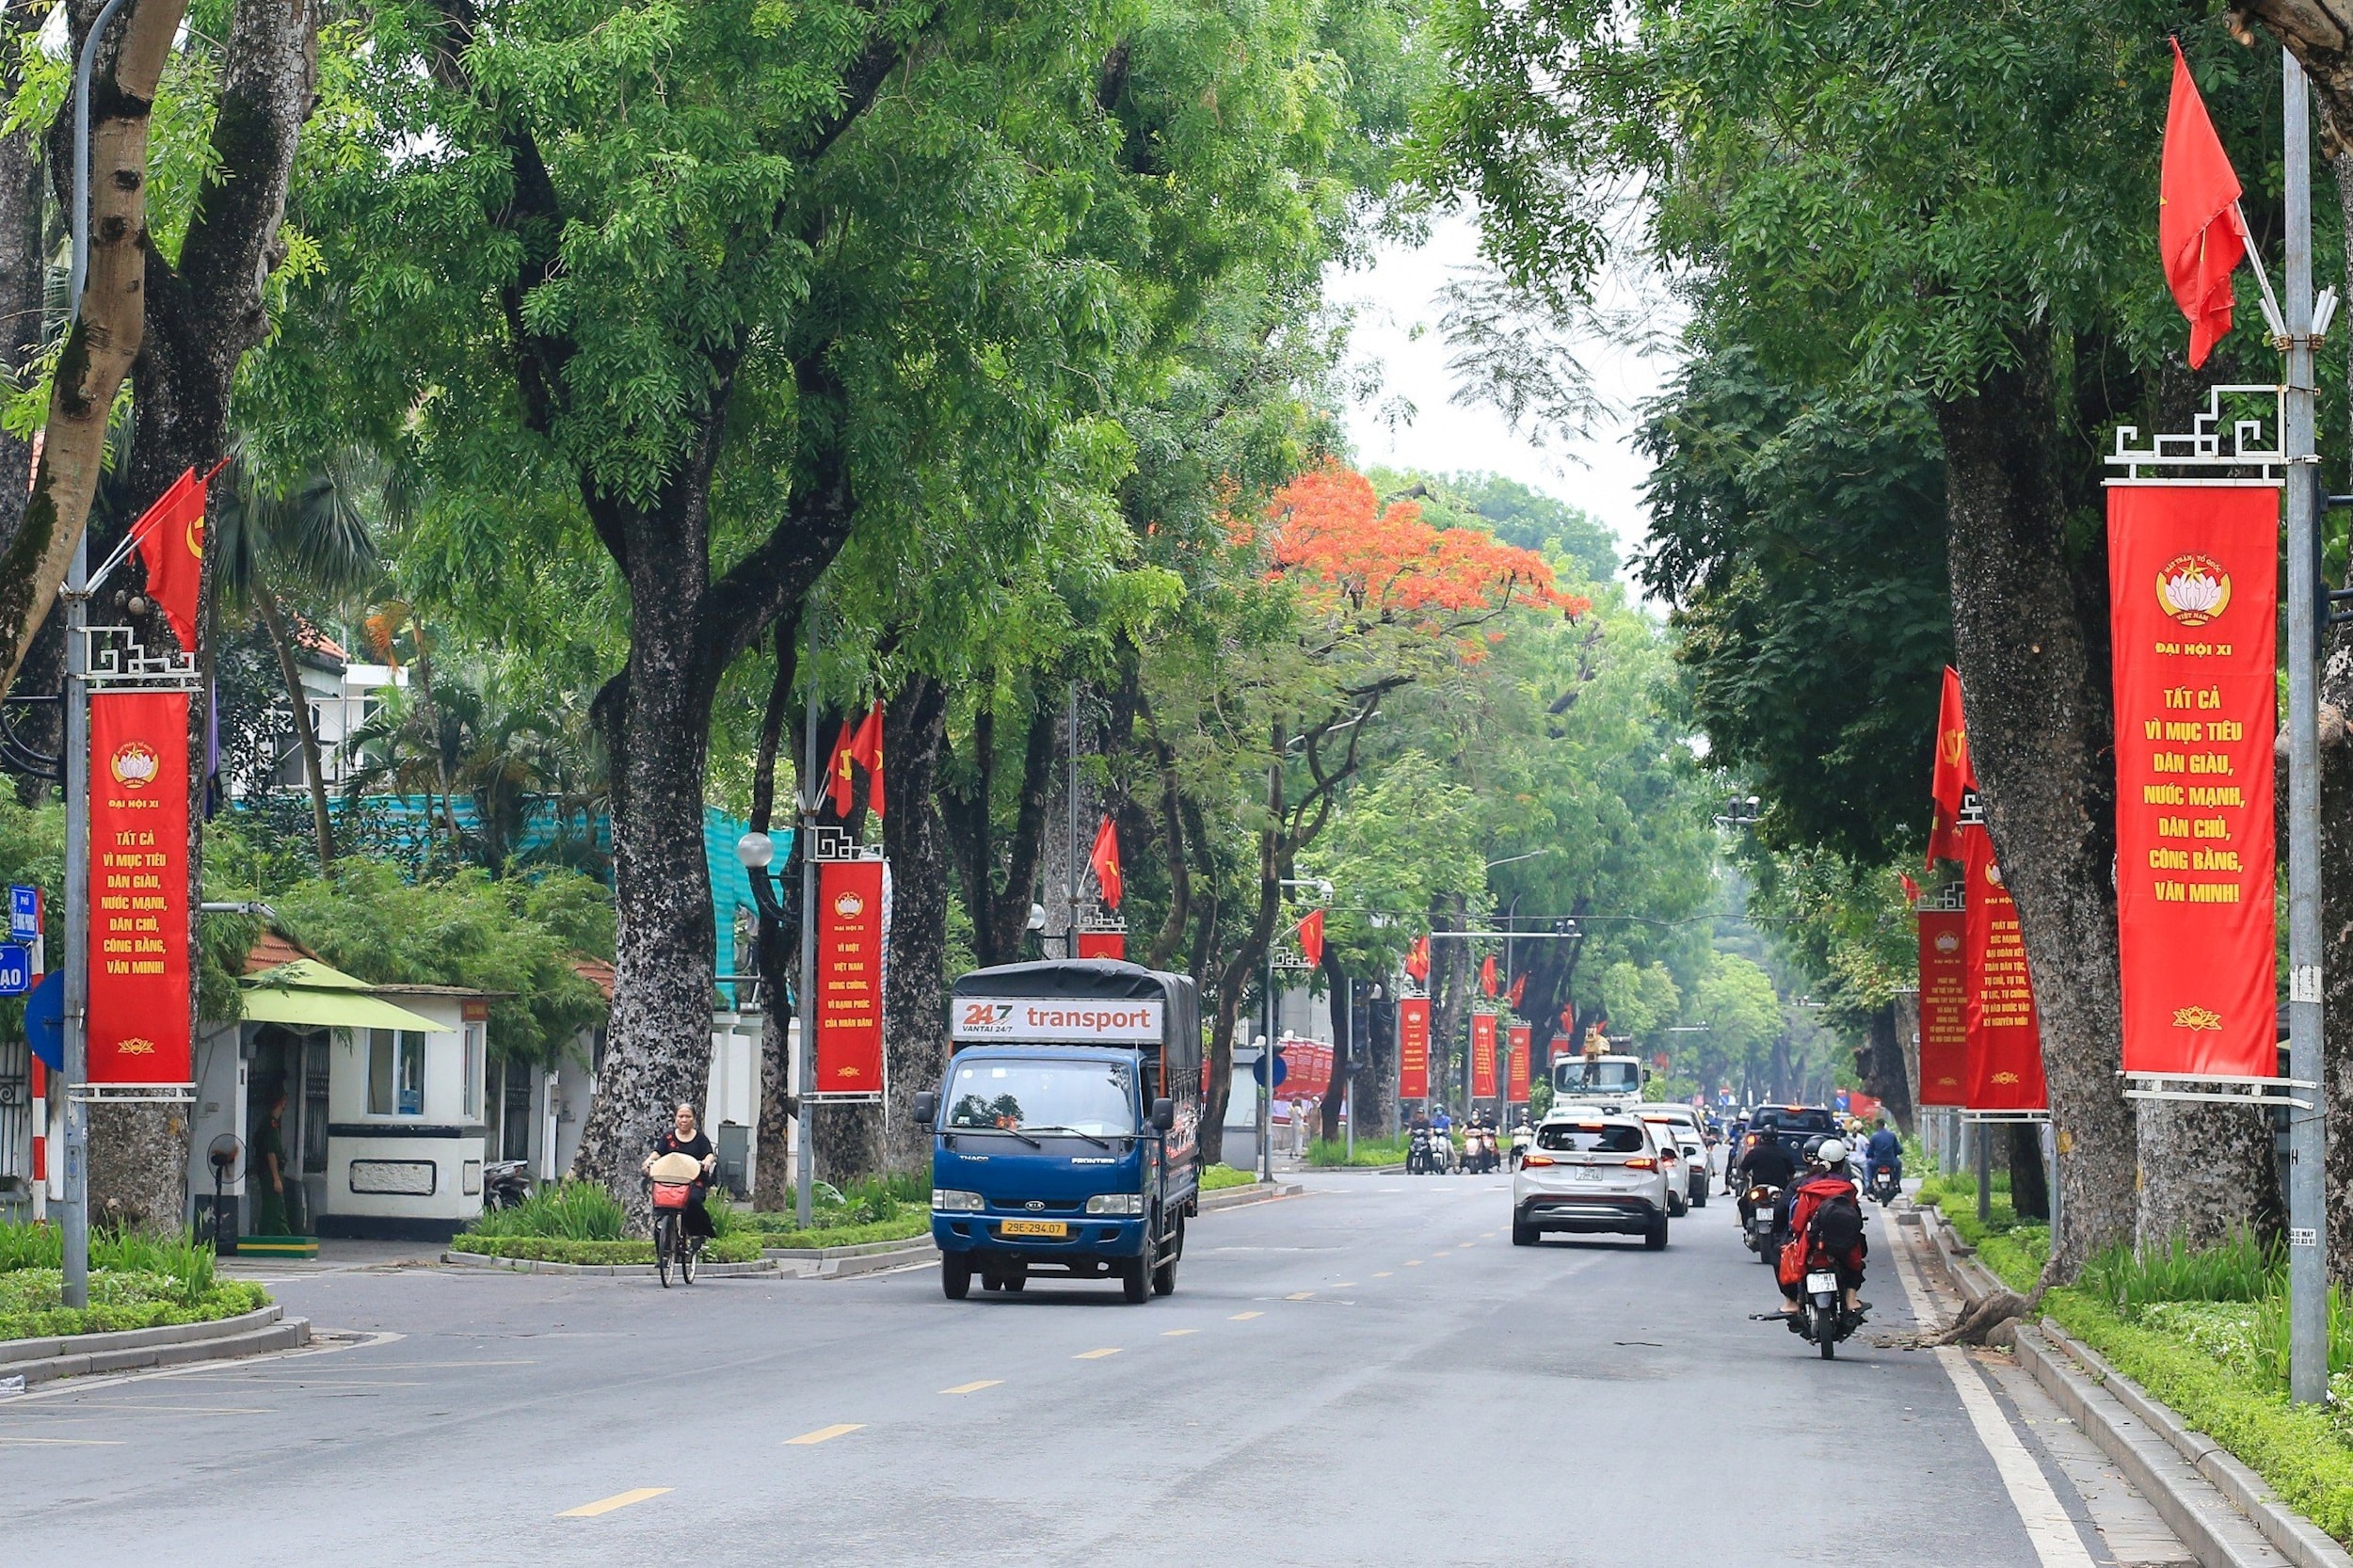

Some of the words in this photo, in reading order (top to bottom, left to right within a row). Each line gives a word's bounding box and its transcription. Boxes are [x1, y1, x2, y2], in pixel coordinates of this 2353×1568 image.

[2177, 612, 2192, 620] VIỆT
[2193, 613, 2209, 621] NAM
[2155, 642, 2180, 656] ĐẠI
[2184, 642, 2212, 658] HỘI
[2216, 644, 2232, 656] XI
[2163, 686, 2193, 709] TẤT
[2197, 685, 2221, 709] CẢ
[2144, 717, 2162, 740] VÌ
[2165, 721, 2202, 745] MỤC
[2206, 720, 2243, 741] TIÊU
[2153, 751, 2185, 773] DÂN
[2189, 751, 2234, 776] GIÀU,
[108, 799, 125, 809] ĐẠI
[128, 799, 147, 809] HỘI
[2144, 782, 2185, 805] NƯỚC
[2189, 787, 2246, 809] MẠNH,
[116, 830, 136, 845] TẤT
[139, 829, 154, 845] CẢ
[2158, 816, 2189, 838] DÂN
[2193, 815, 2232, 841] CHỦ,
[103, 851, 113, 866] VÌ
[116, 854, 142, 869] MỤC
[145, 852, 166, 866] TIÊU
[2149, 847, 2189, 870] CÔNG
[2193, 846, 2244, 873] BẰNG,
[107, 873, 130, 888] DÂN
[133, 873, 161, 890] GIÀU,
[2154, 880, 2185, 901] VĂN
[2189, 883, 2240, 903] MINH!
[101, 894, 129, 909] NƯỚC
[132, 896, 168, 911] MẠNH,
[110, 917, 132, 931] DÂN
[135, 915, 160, 933] CHỦ,
[103, 938, 132, 952] CÔNG
[135, 936, 166, 954] BẰNG,
[107, 959, 129, 974] VĂN
[132, 961, 164, 974] MINH!
[963, 1004, 1013, 1024] 247
[1027, 1007, 1150, 1032] transport
[1007, 1223, 1061, 1233] 29E-294.07
